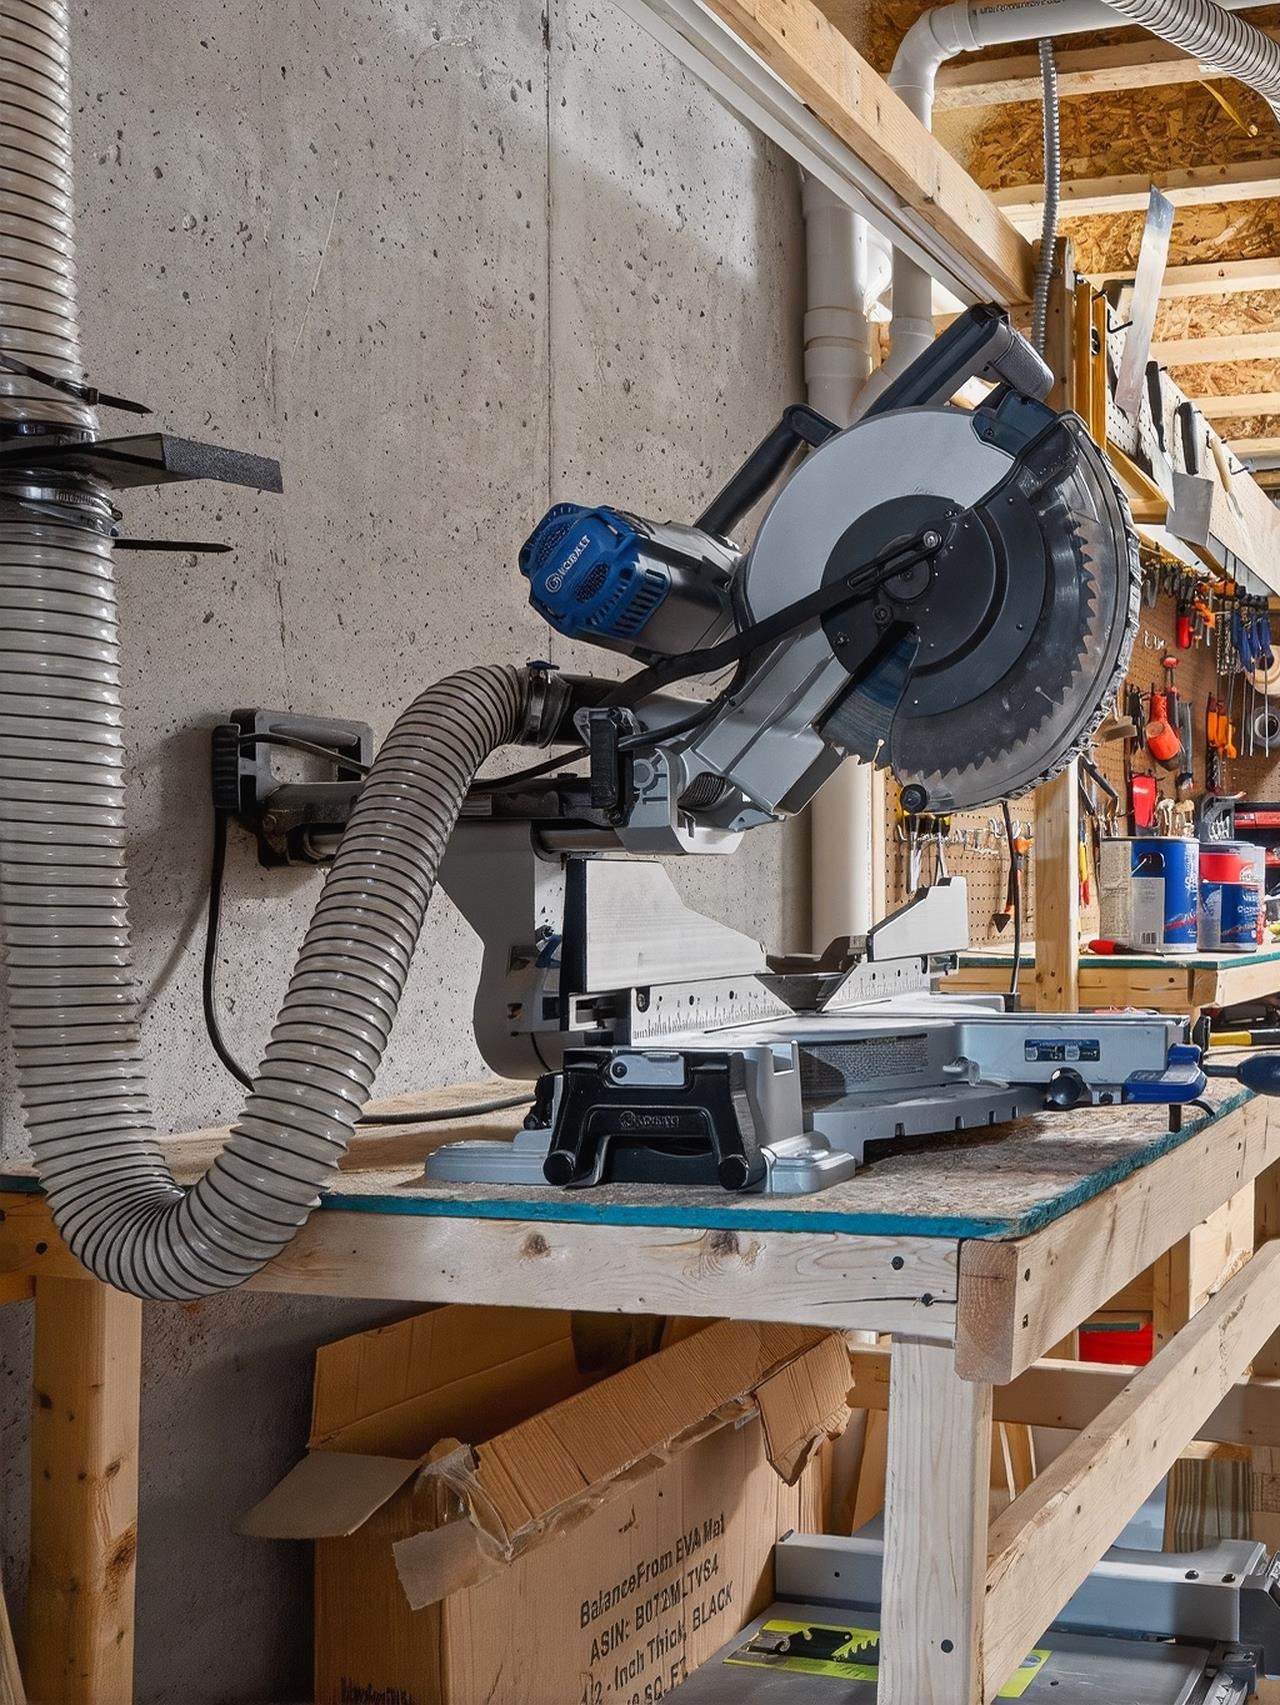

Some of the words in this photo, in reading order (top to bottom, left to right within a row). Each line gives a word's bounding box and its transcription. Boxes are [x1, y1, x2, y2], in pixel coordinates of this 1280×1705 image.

[580, 1549, 673, 1629] BalanceFrom
[676, 1527, 701, 1563] EVA
[703, 1511, 725, 1545] Mat
[589, 1618, 630, 1667] ASIN:
[614, 1650, 645, 1691] Inch
[692, 1581, 734, 1632] BLACK
